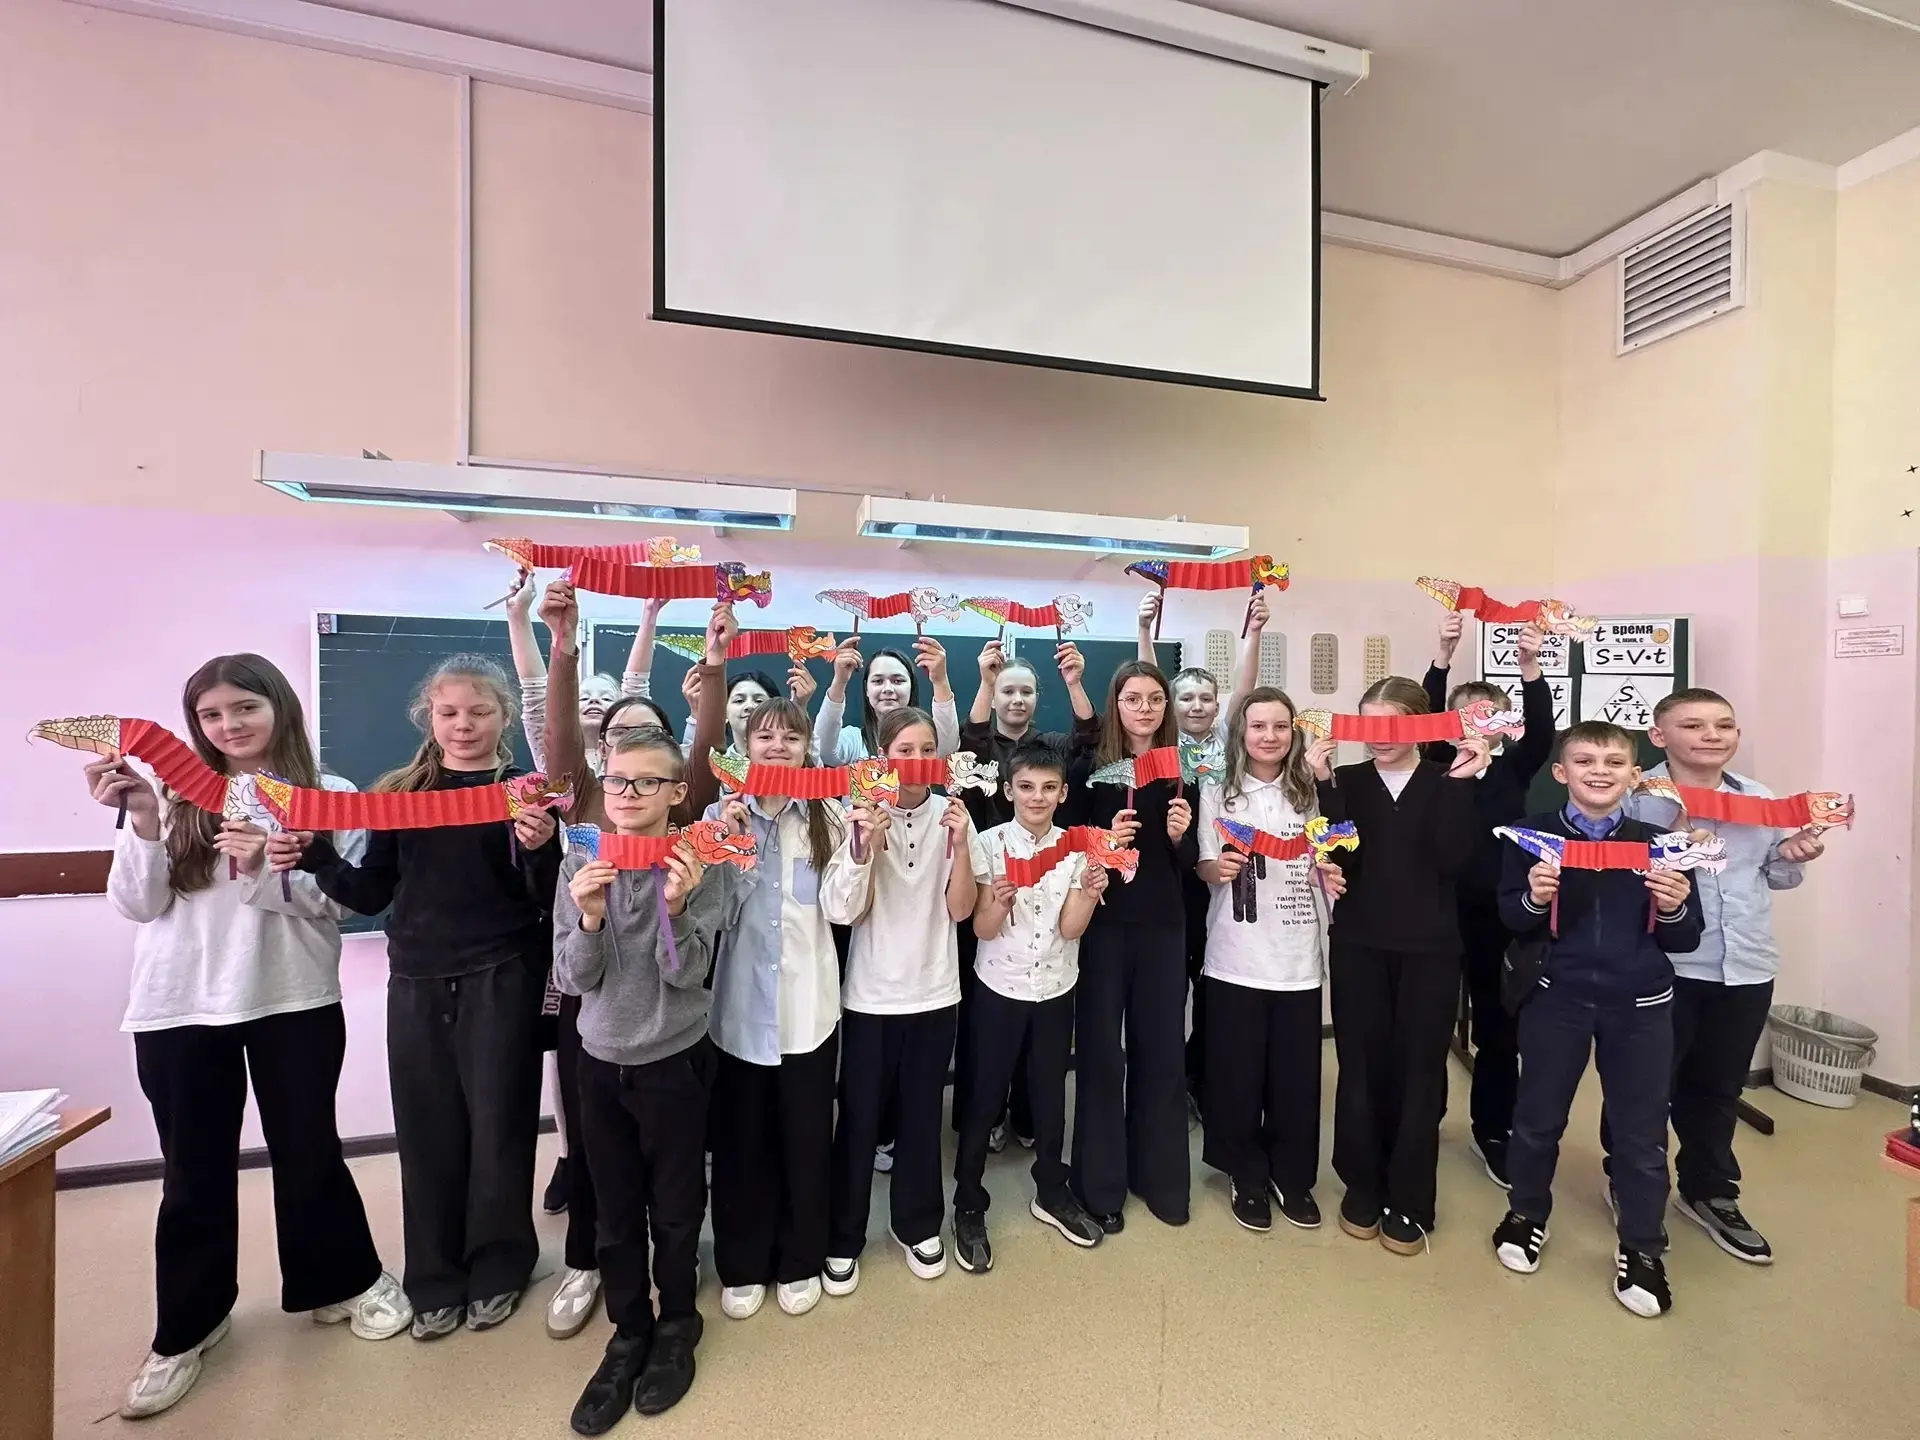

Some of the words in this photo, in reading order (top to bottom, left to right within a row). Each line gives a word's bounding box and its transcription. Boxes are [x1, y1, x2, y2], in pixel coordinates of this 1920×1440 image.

[1492, 628, 1506, 644] S
[1594, 626, 1606, 642] t
[1612, 625, 1654, 636] время
[1492, 650, 1509, 665] V
[1513, 650, 1558, 658] сость
[1619, 686, 1634, 702] S
[1603, 708, 1622, 722] V
[1637, 709, 1650, 725] t
